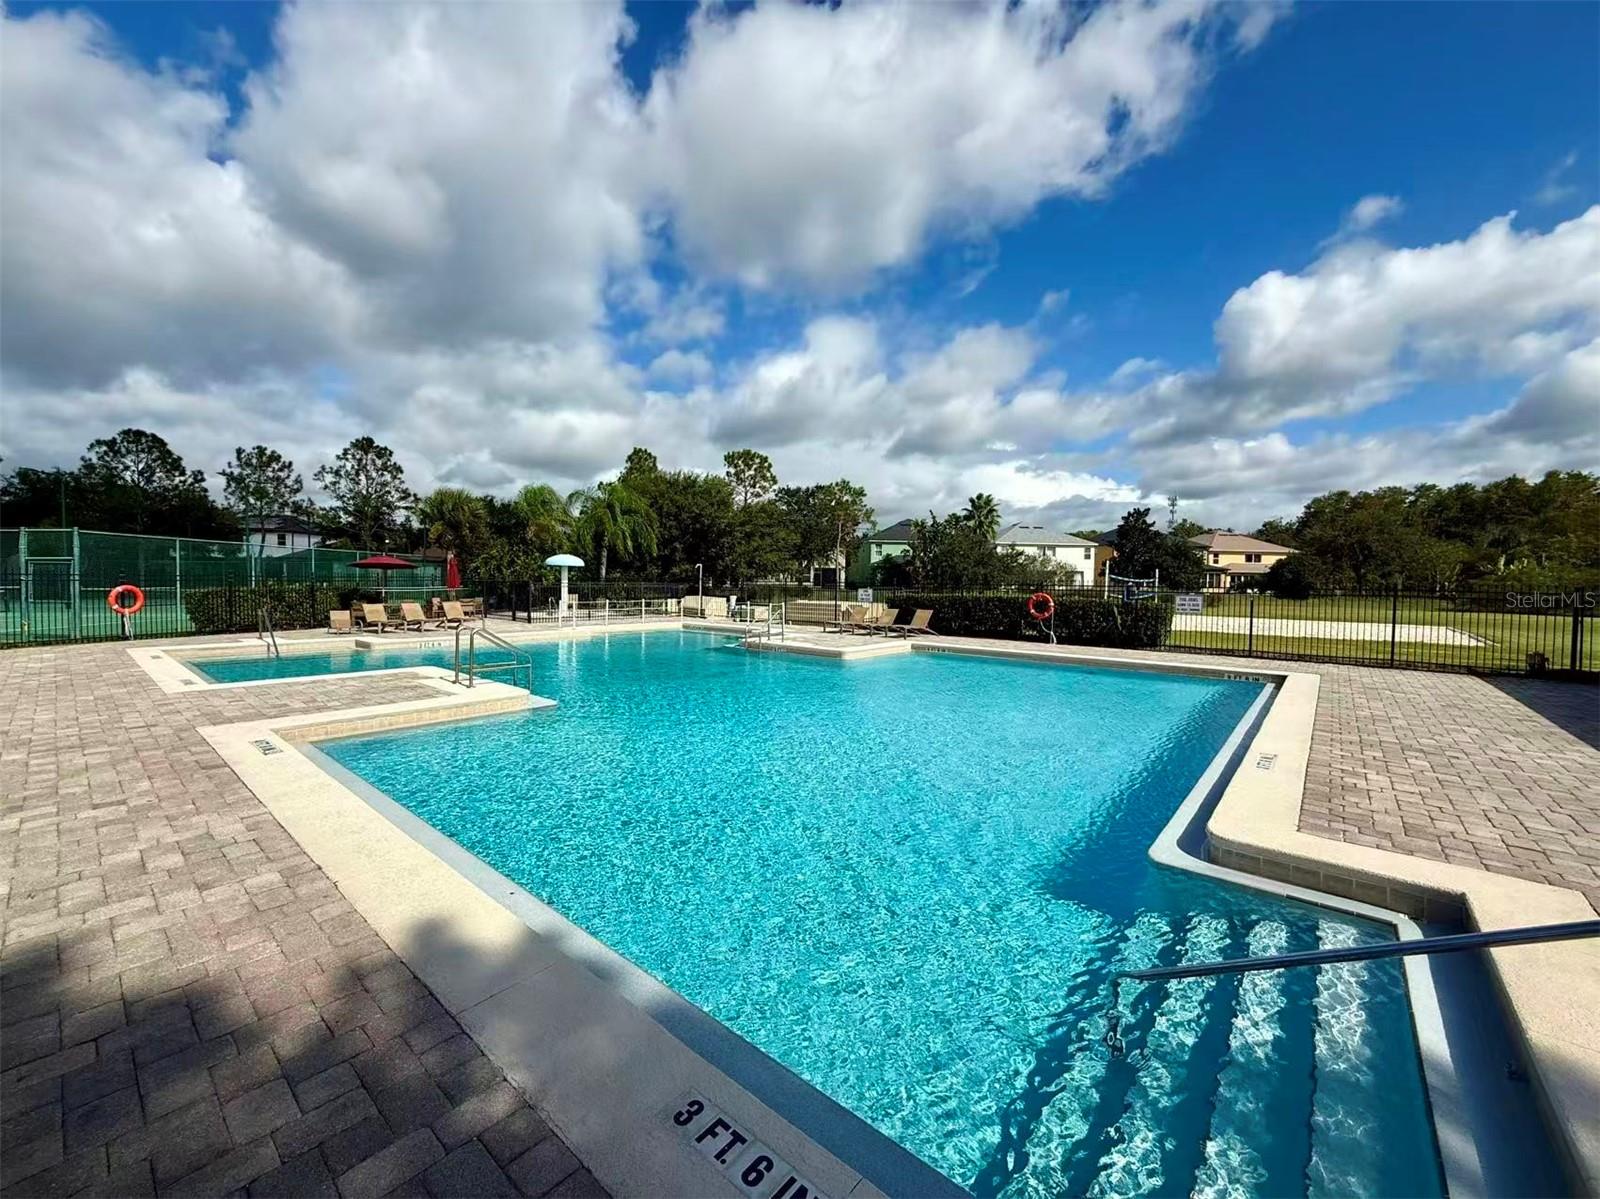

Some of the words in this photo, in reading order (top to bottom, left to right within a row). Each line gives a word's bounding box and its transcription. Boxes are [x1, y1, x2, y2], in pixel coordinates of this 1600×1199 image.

[673, 1100, 705, 1126] 3
[695, 1117, 748, 1165] FT.
[741, 1155, 774, 1187] 6
